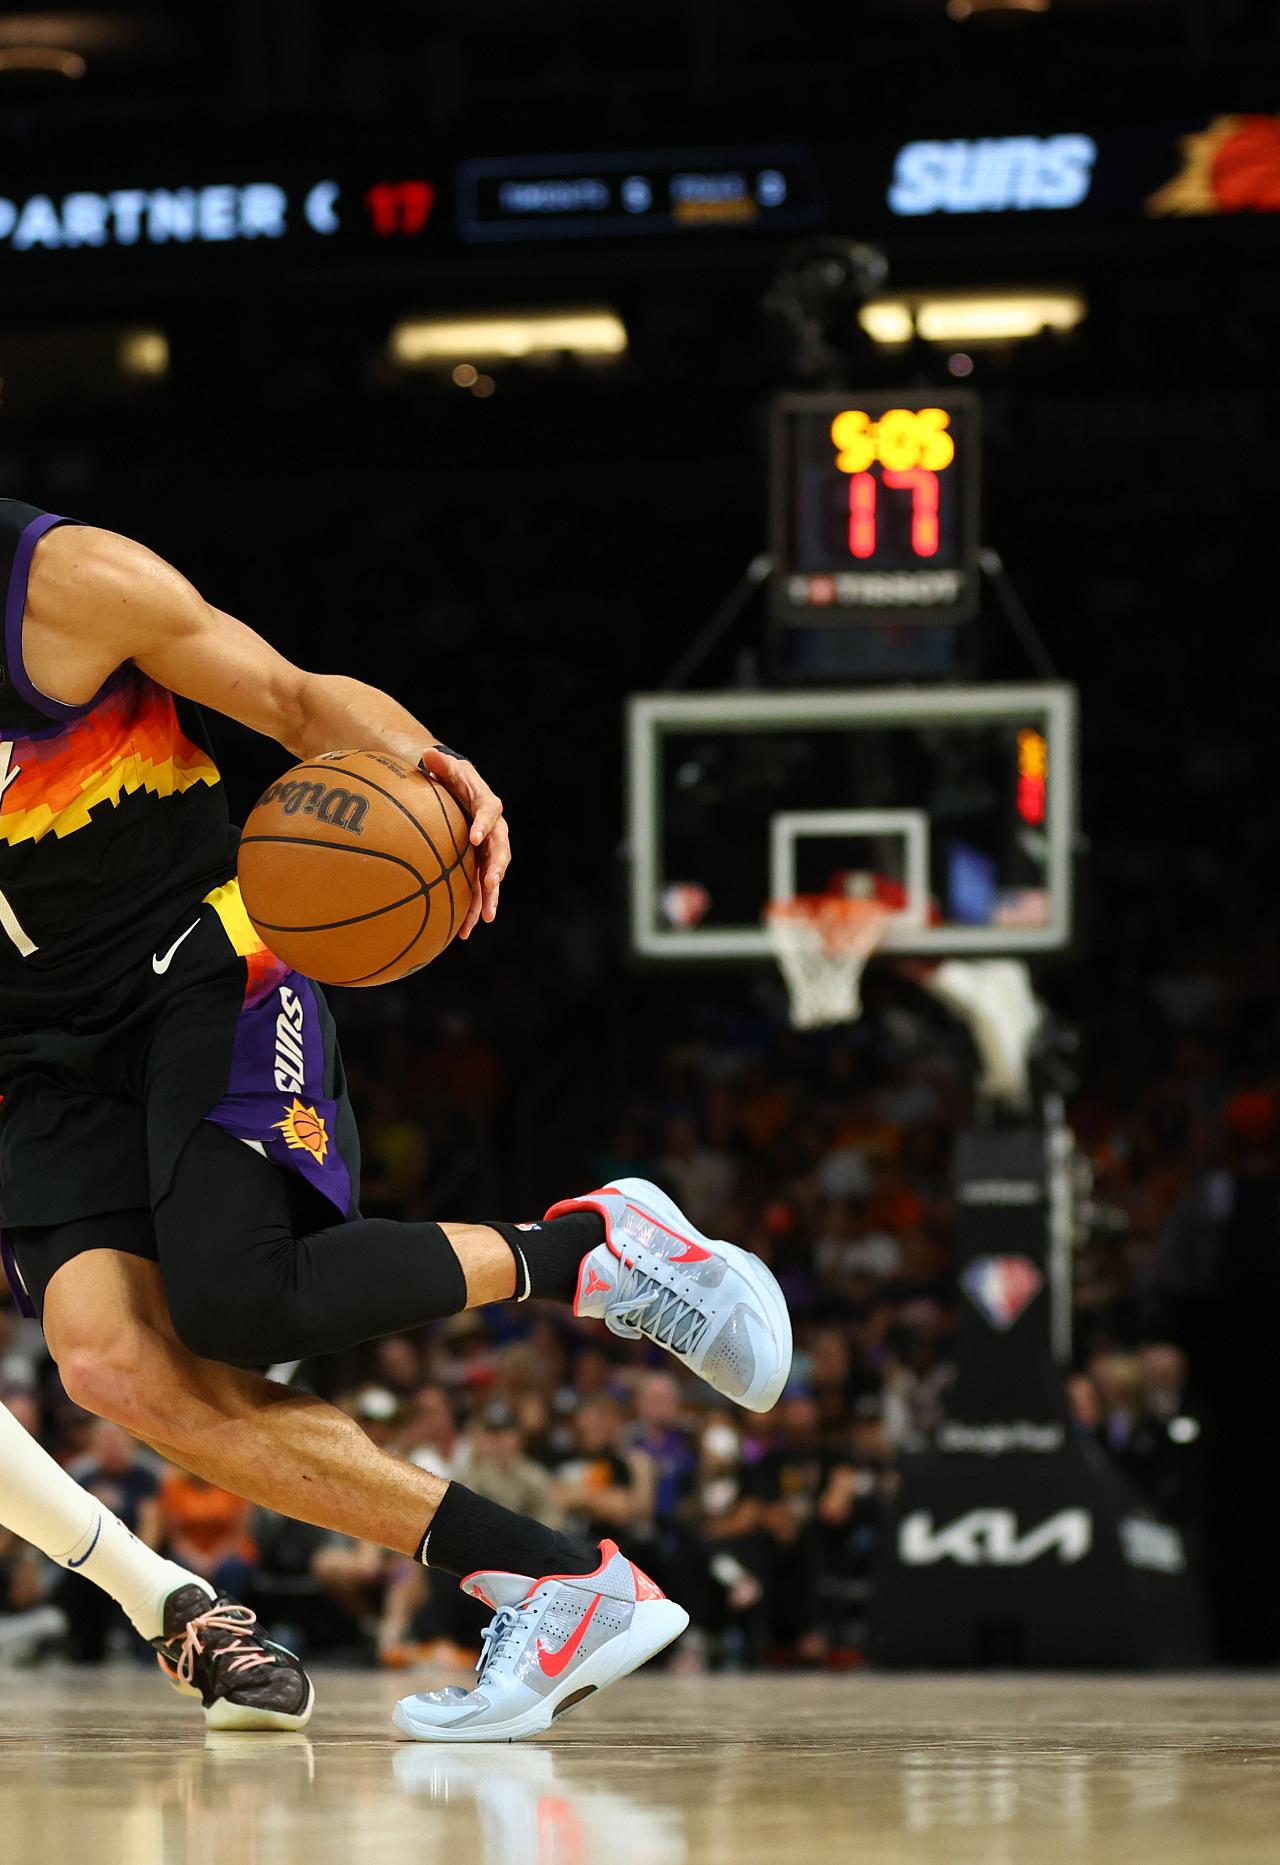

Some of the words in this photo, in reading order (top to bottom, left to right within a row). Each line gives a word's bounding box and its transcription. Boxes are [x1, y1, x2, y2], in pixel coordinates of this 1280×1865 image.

[888, 133, 1097, 216] SUNS
[848, 468, 940, 559] 17
[256, 779, 370, 836] Wilso
[273, 985, 305, 1095] SUNS
